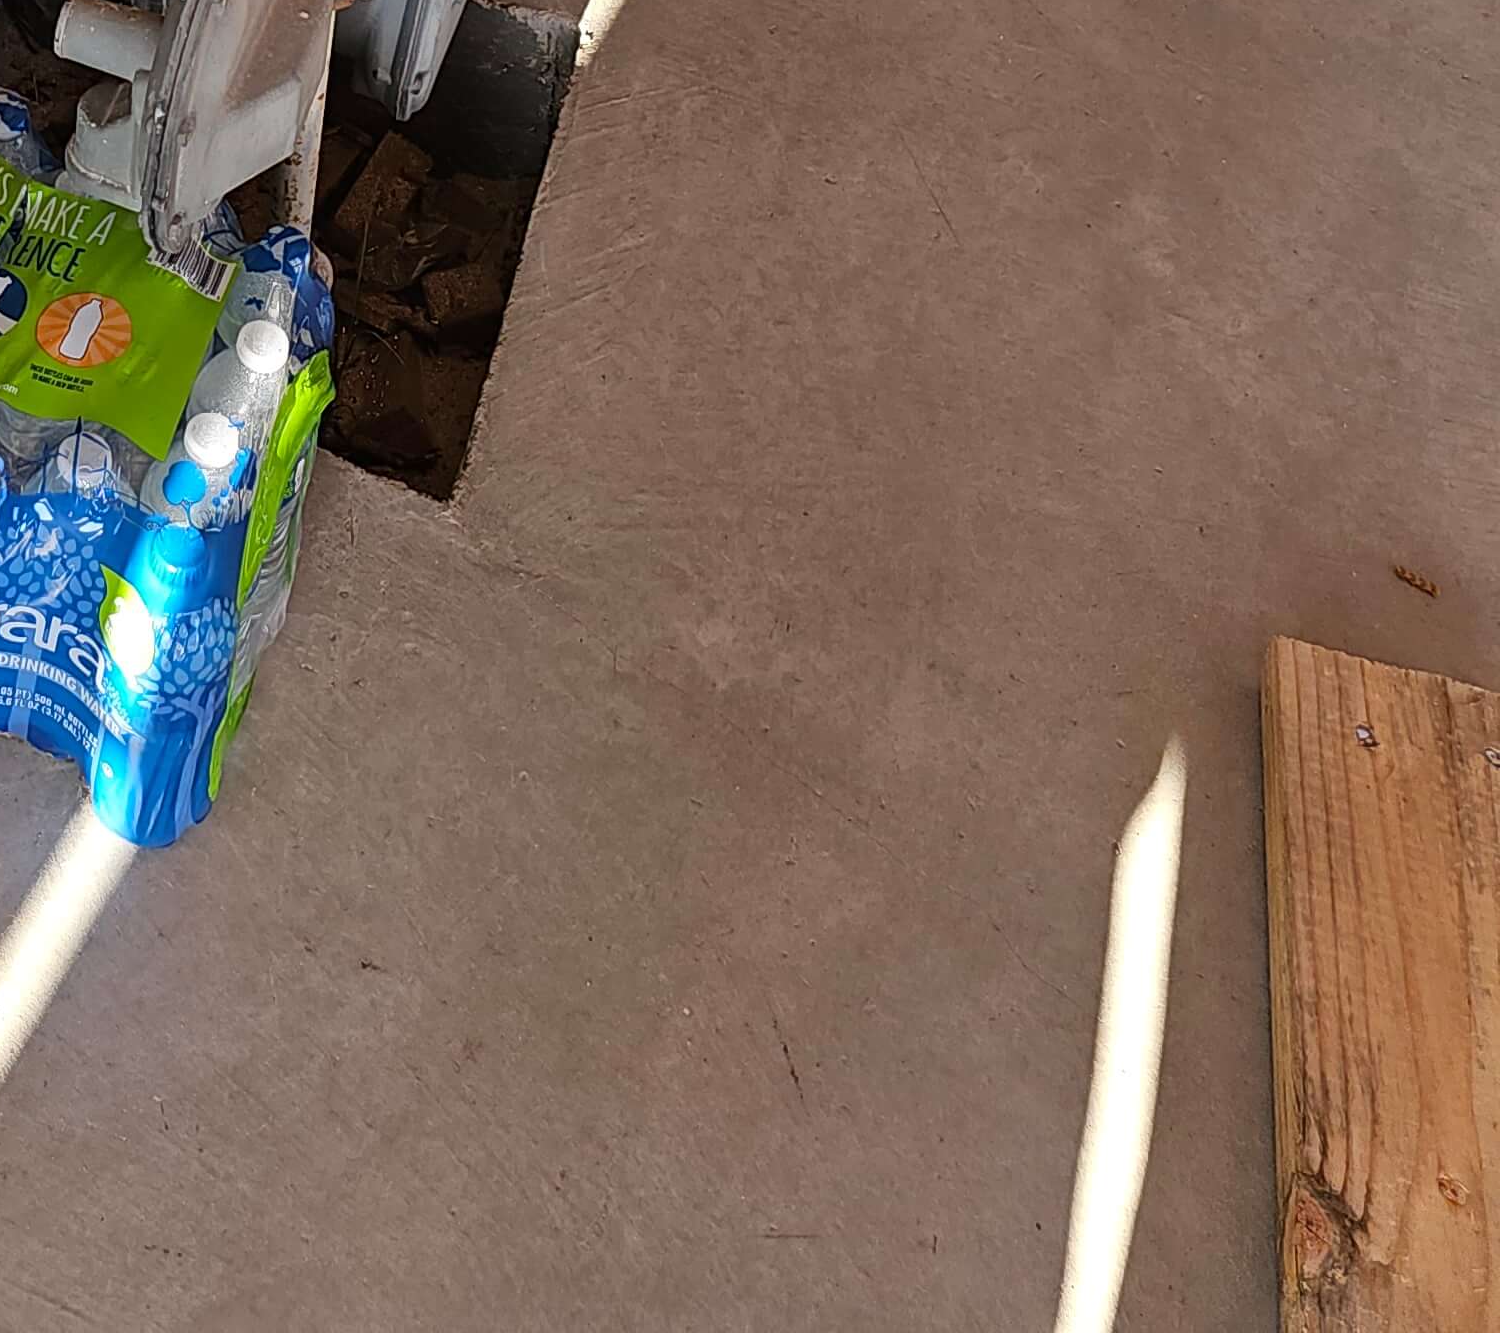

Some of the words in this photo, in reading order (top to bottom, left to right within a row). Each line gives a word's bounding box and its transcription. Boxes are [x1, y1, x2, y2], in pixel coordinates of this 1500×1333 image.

[9, 183, 91, 240] MAKE
[85, 211, 117, 246] A
[80, 686, 123, 737] WATER
